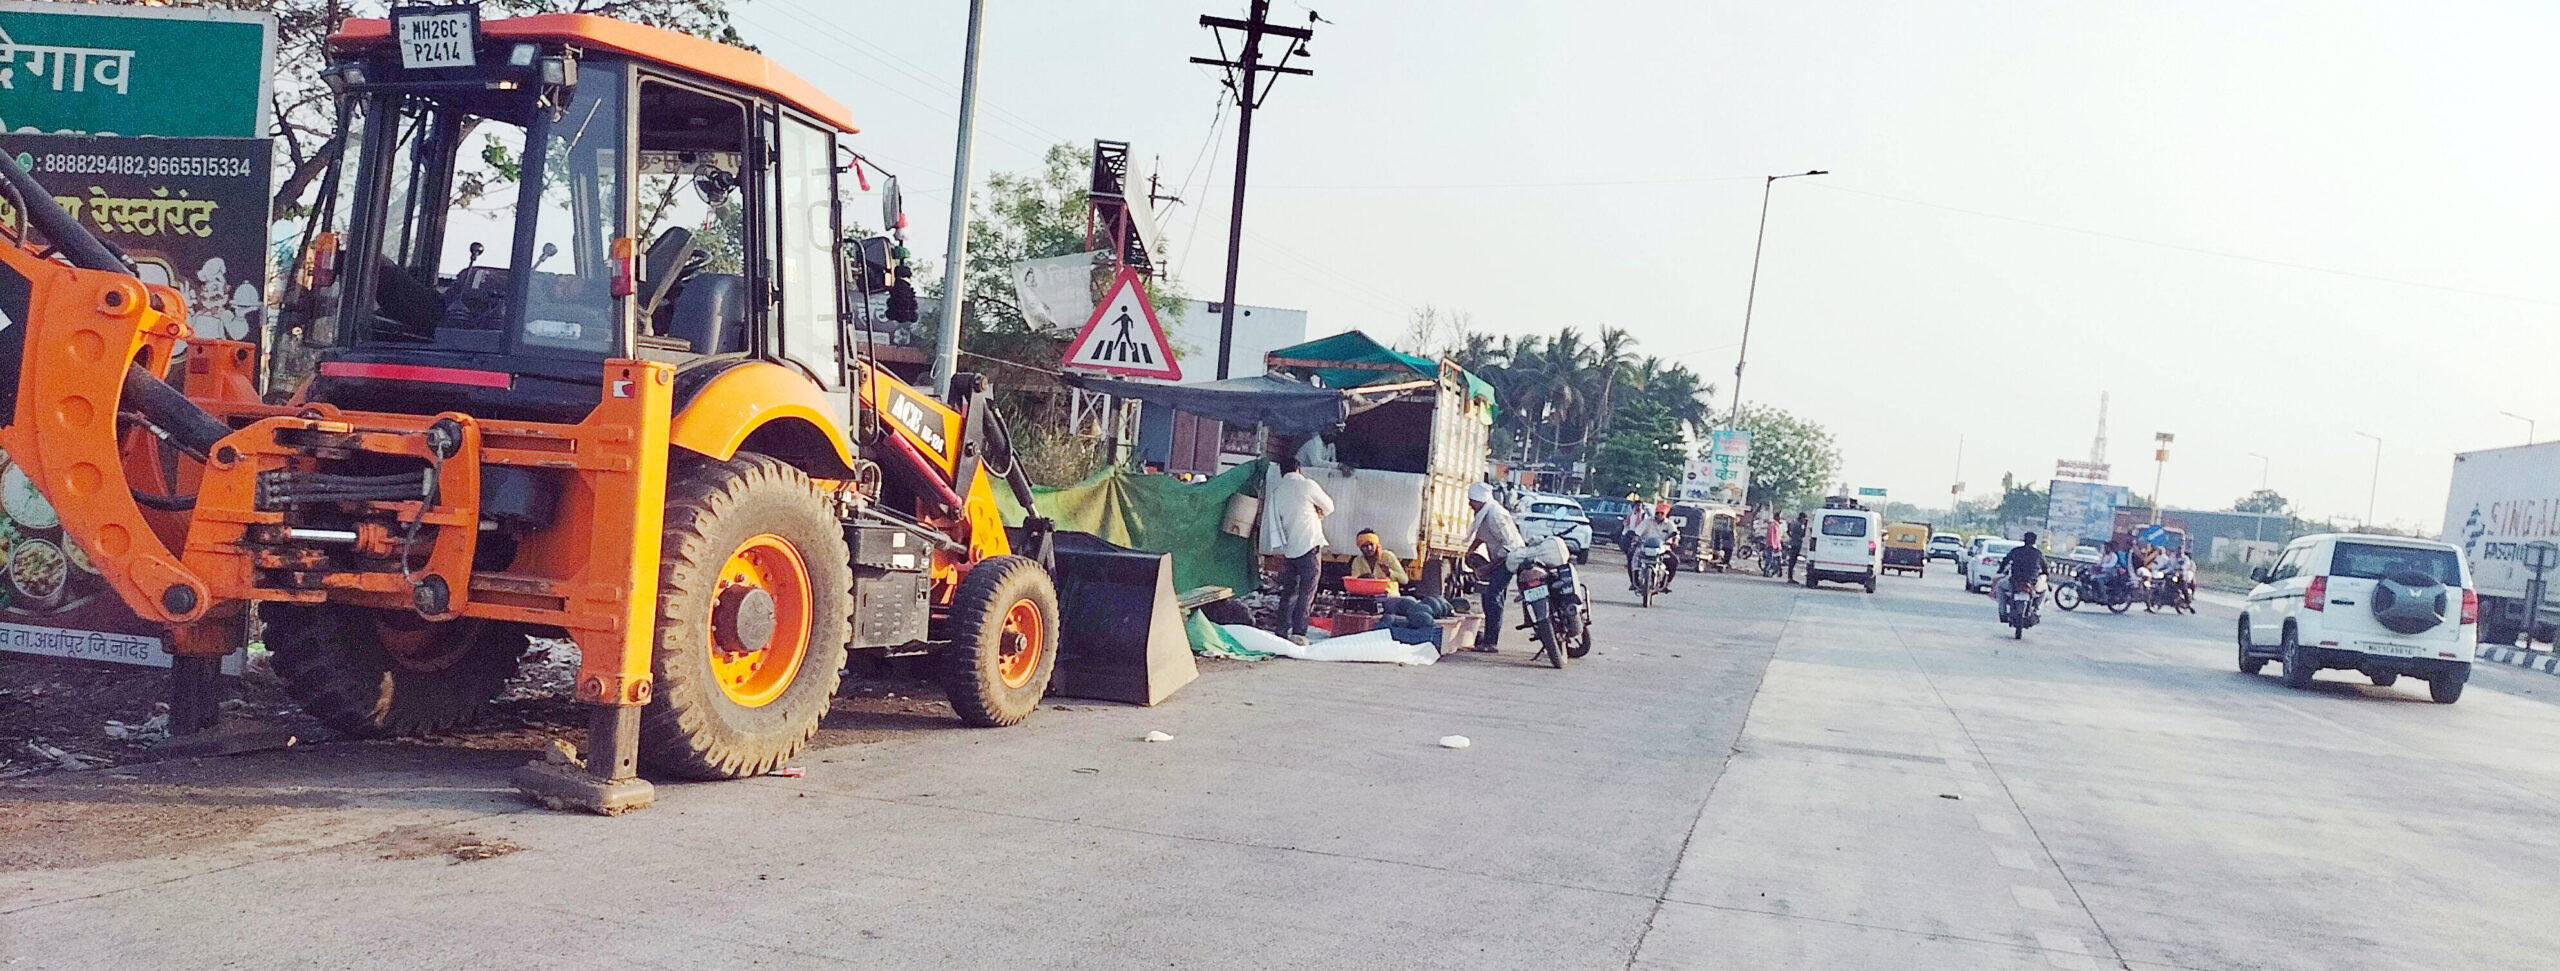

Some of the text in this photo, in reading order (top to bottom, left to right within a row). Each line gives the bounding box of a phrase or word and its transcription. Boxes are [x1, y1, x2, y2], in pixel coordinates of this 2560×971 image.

[412, 19, 458, 40] MH26C
[414, 41, 460, 62] P2414
[89, 186, 219, 237] रेस्टॉरंट
[891, 393, 923, 434] ACE
